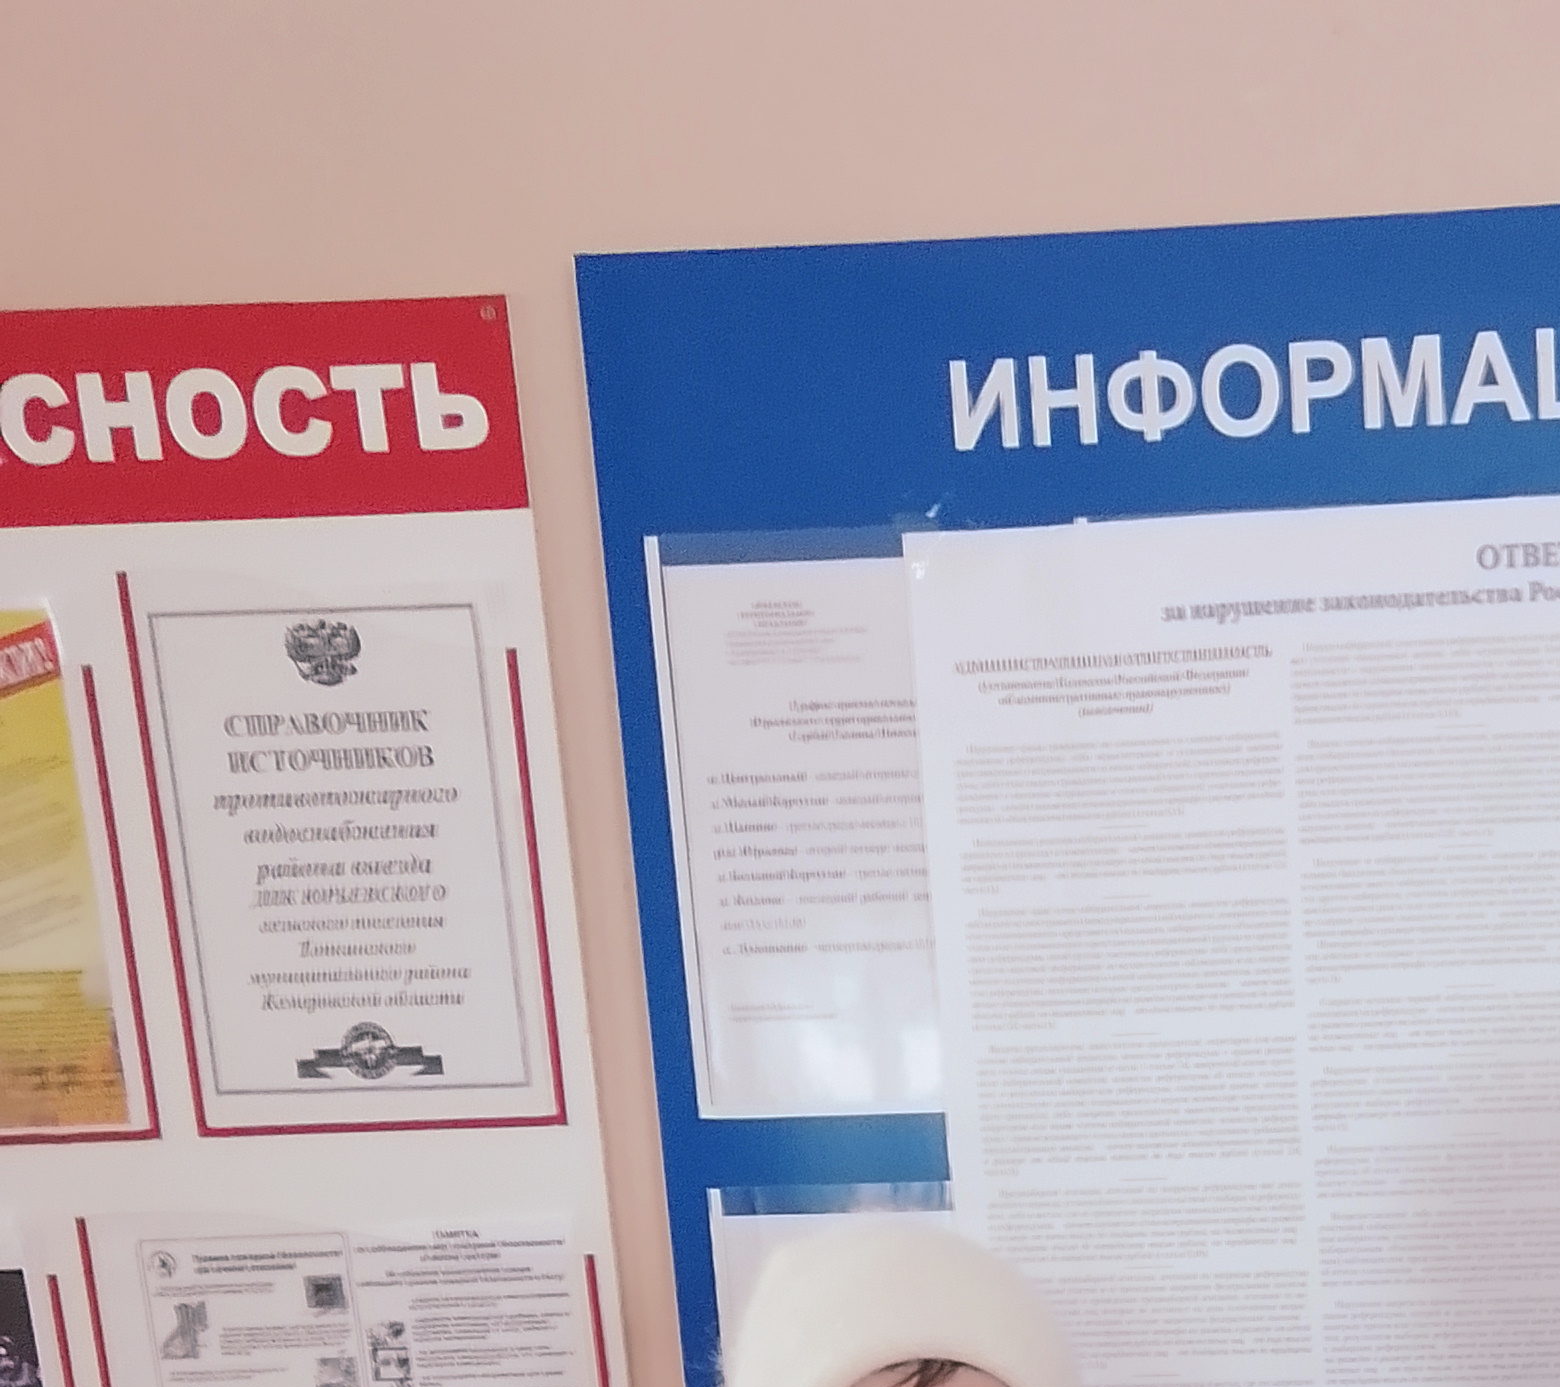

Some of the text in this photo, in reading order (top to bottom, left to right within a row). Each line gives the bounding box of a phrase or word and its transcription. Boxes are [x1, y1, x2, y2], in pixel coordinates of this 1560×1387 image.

[0, 362, 490, 466] СНОСТЬ
[1161, 603, 1186, 622] за
[1190, 595, 1315, 624] нарушение
[1320, 586, 1523, 614] законодательства
[224, 709, 430, 738] СПРАВОЧНИК
[227, 744, 435, 774] ИСТОЧНИКОВ
